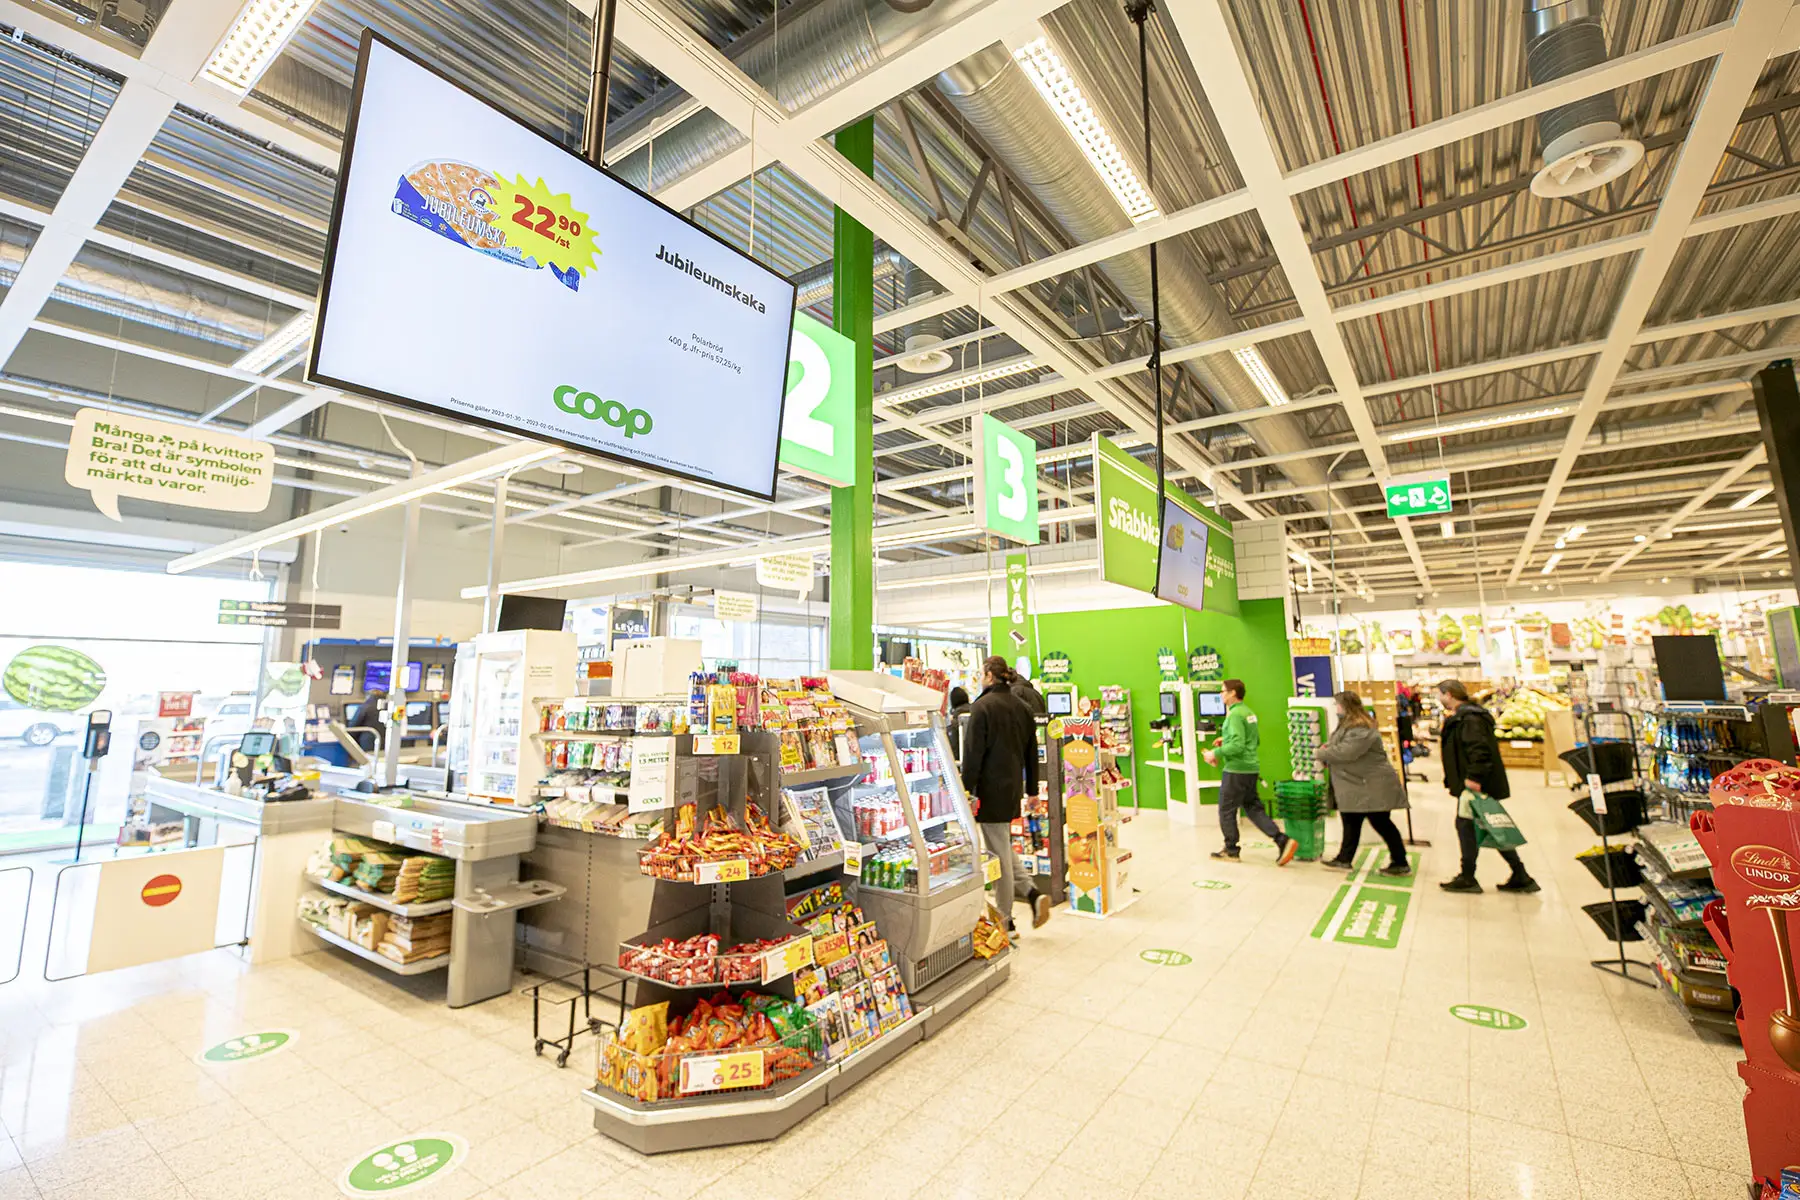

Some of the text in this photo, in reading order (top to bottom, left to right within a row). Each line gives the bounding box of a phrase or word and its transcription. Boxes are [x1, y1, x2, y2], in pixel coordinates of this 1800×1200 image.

[512, 193, 581, 241] 22 90
[655, 244, 766, 315] Jubileumskaka
[668, 335, 682, 347] 400
[689, 345, 715, 361] Jfr-pris
[715, 355, 742, 375] 57,25/kg
[691, 332, 724, 354] Polarbröd
[450, 397, 475, 409] Priserna
[474, 404, 491, 413] gäller
[491, 408, 522, 422] 2023-01-30
[552, 384, 653, 440] coop
[781, 330, 834, 458] 2
[91, 436, 262, 476] Bra! Det är symbolen
[93, 421, 264, 462] Många på kvittot?
[86, 466, 207, 495] märkta varor.
[89, 451, 255, 489] för att du valt miljö-
[997, 433, 1028, 523] 3
[722, 740, 733, 750] 12
[725, 867, 741, 878] 24
[1743, 851, 1780, 867] Lindt
[1745, 866, 1791, 884] LINDOR
[728, 1062, 752, 1082] 25
